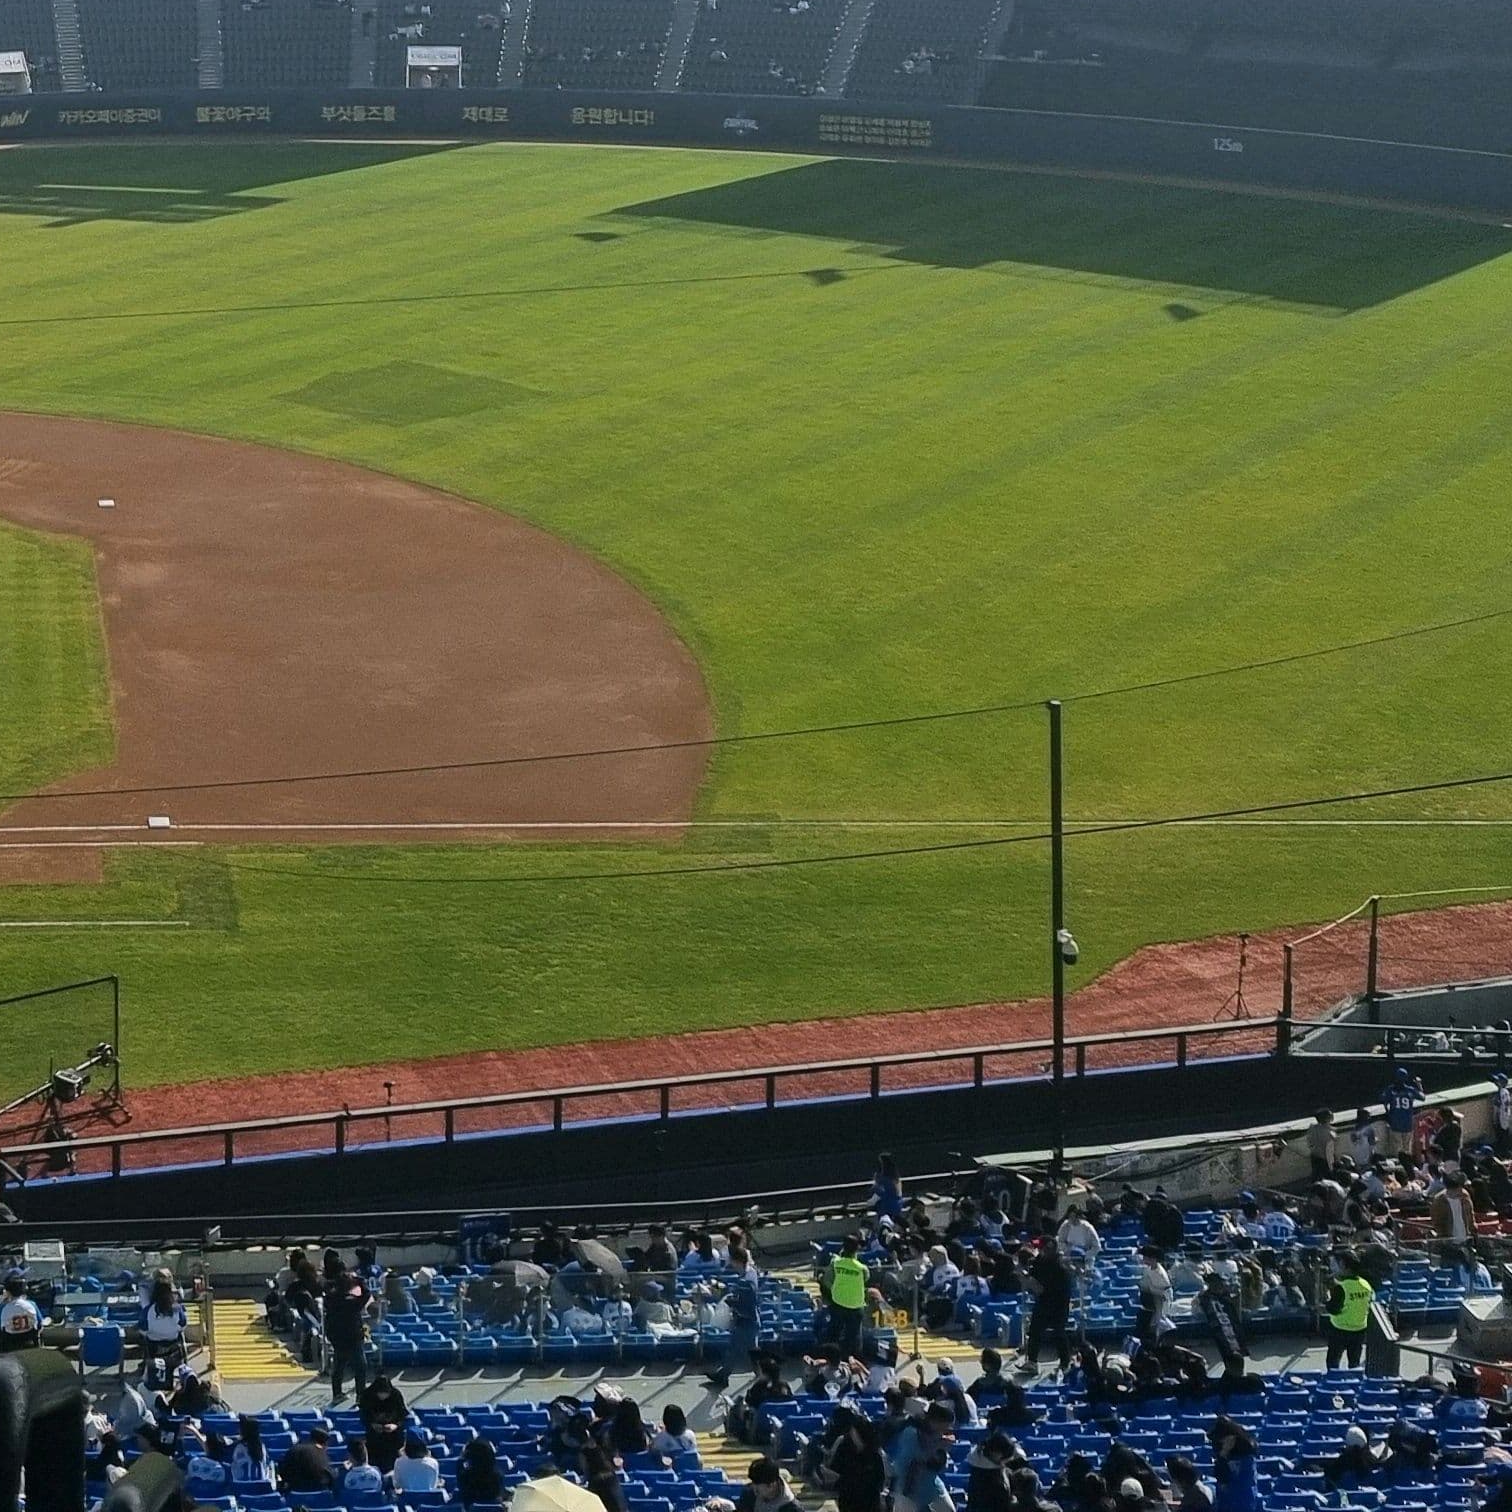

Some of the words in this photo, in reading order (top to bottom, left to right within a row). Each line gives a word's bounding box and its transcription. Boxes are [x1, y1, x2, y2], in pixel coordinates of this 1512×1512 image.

[462, 106, 509, 123] 제대로
[571, 107, 655, 126] 응원합니다!
[1395, 1097, 1410, 1110] 19
